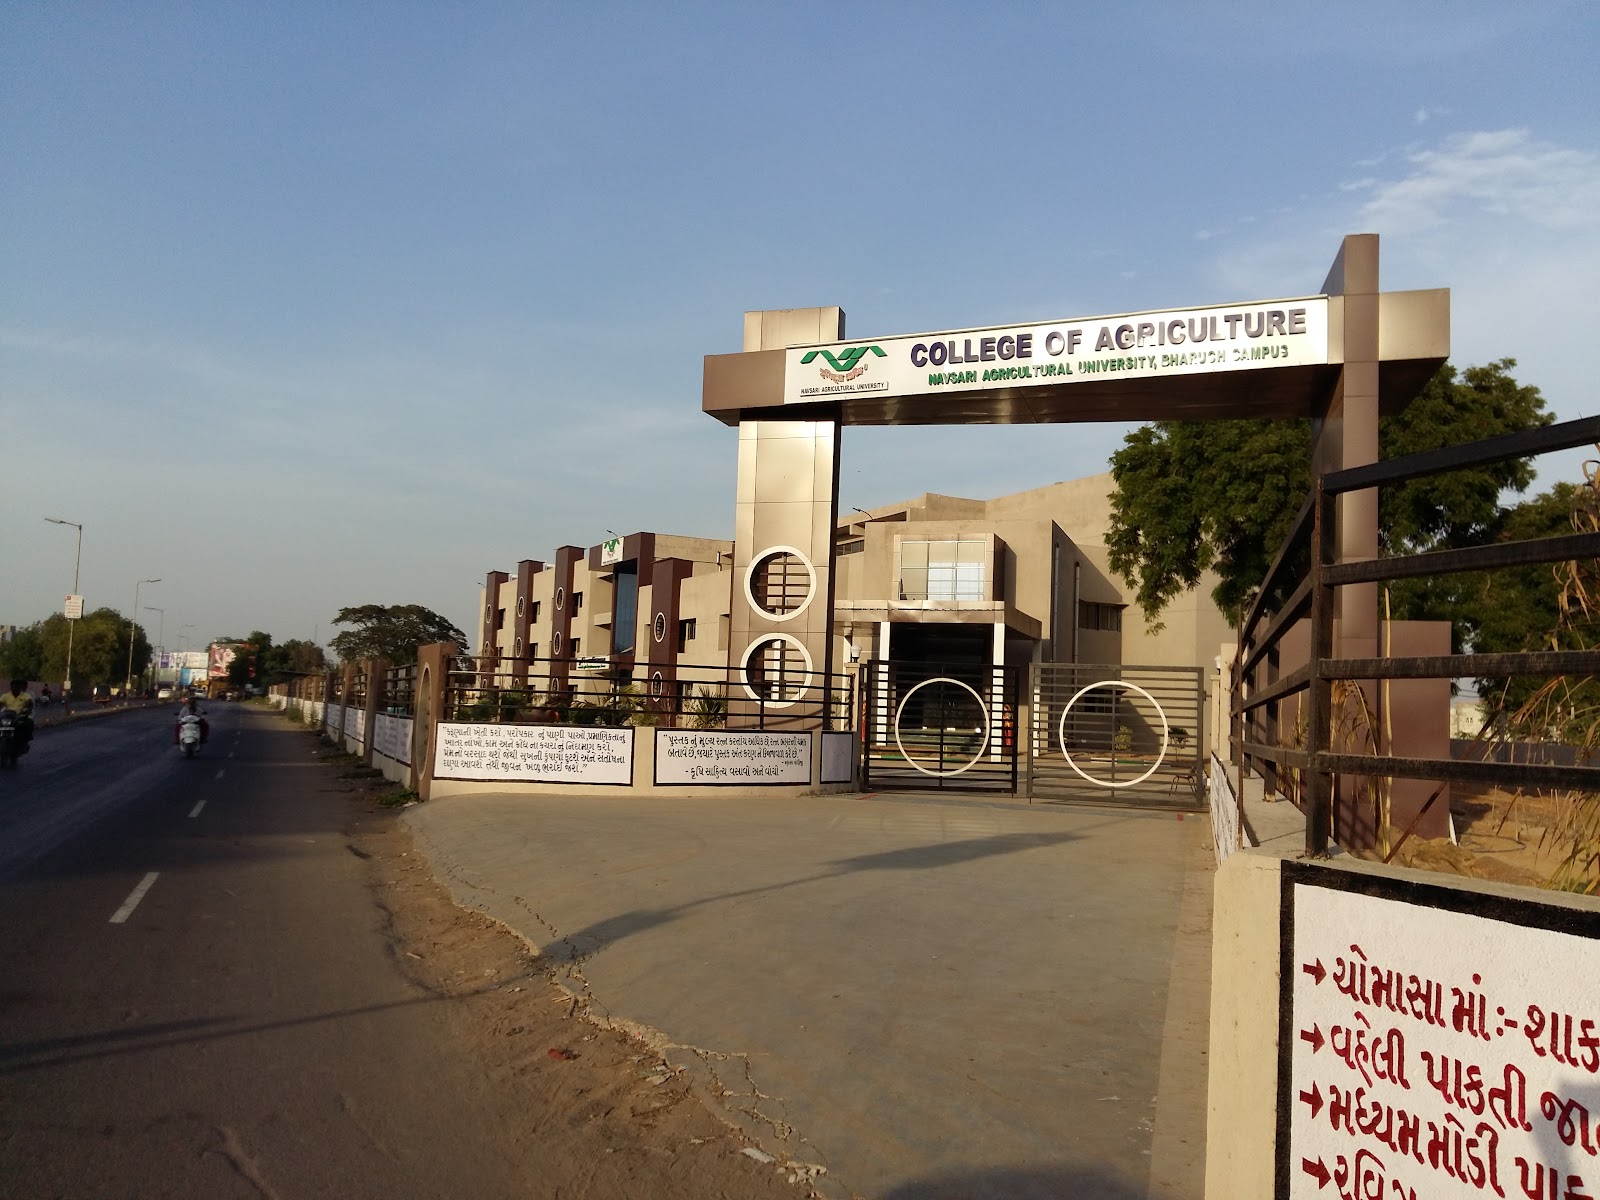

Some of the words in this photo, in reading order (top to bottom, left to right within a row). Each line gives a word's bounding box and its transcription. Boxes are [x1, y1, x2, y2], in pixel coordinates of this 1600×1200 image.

[911, 333, 1032, 367] COLLEGE
[1045, 329, 1082, 356] OF
[1095, 308, 1306, 351] AGRICULTURE
[801, 387, 819, 395] NAVSARI
[821, 384, 855, 392] AGRICULTURAL
[856, 382, 885, 390] UNIVERSITY
[928, 369, 977, 385] NAVSARI
[982, 362, 1073, 381] AGRICULTURAL
[1078, 354, 1157, 374] UNIVERSITY,
[1161, 350, 1226, 368] BHARUCH
[1232, 344, 1289, 362] CAMPUS
[506, 727, 534, 738] પરોપકાર
[1332, 944, 1446, 1029] ચોમાસા
[1331, 1011, 1411, 1089] વહેલી
[1420, 1050, 1532, 1133] પાકતી
[1540, 1091, 1600, 1157] જા
